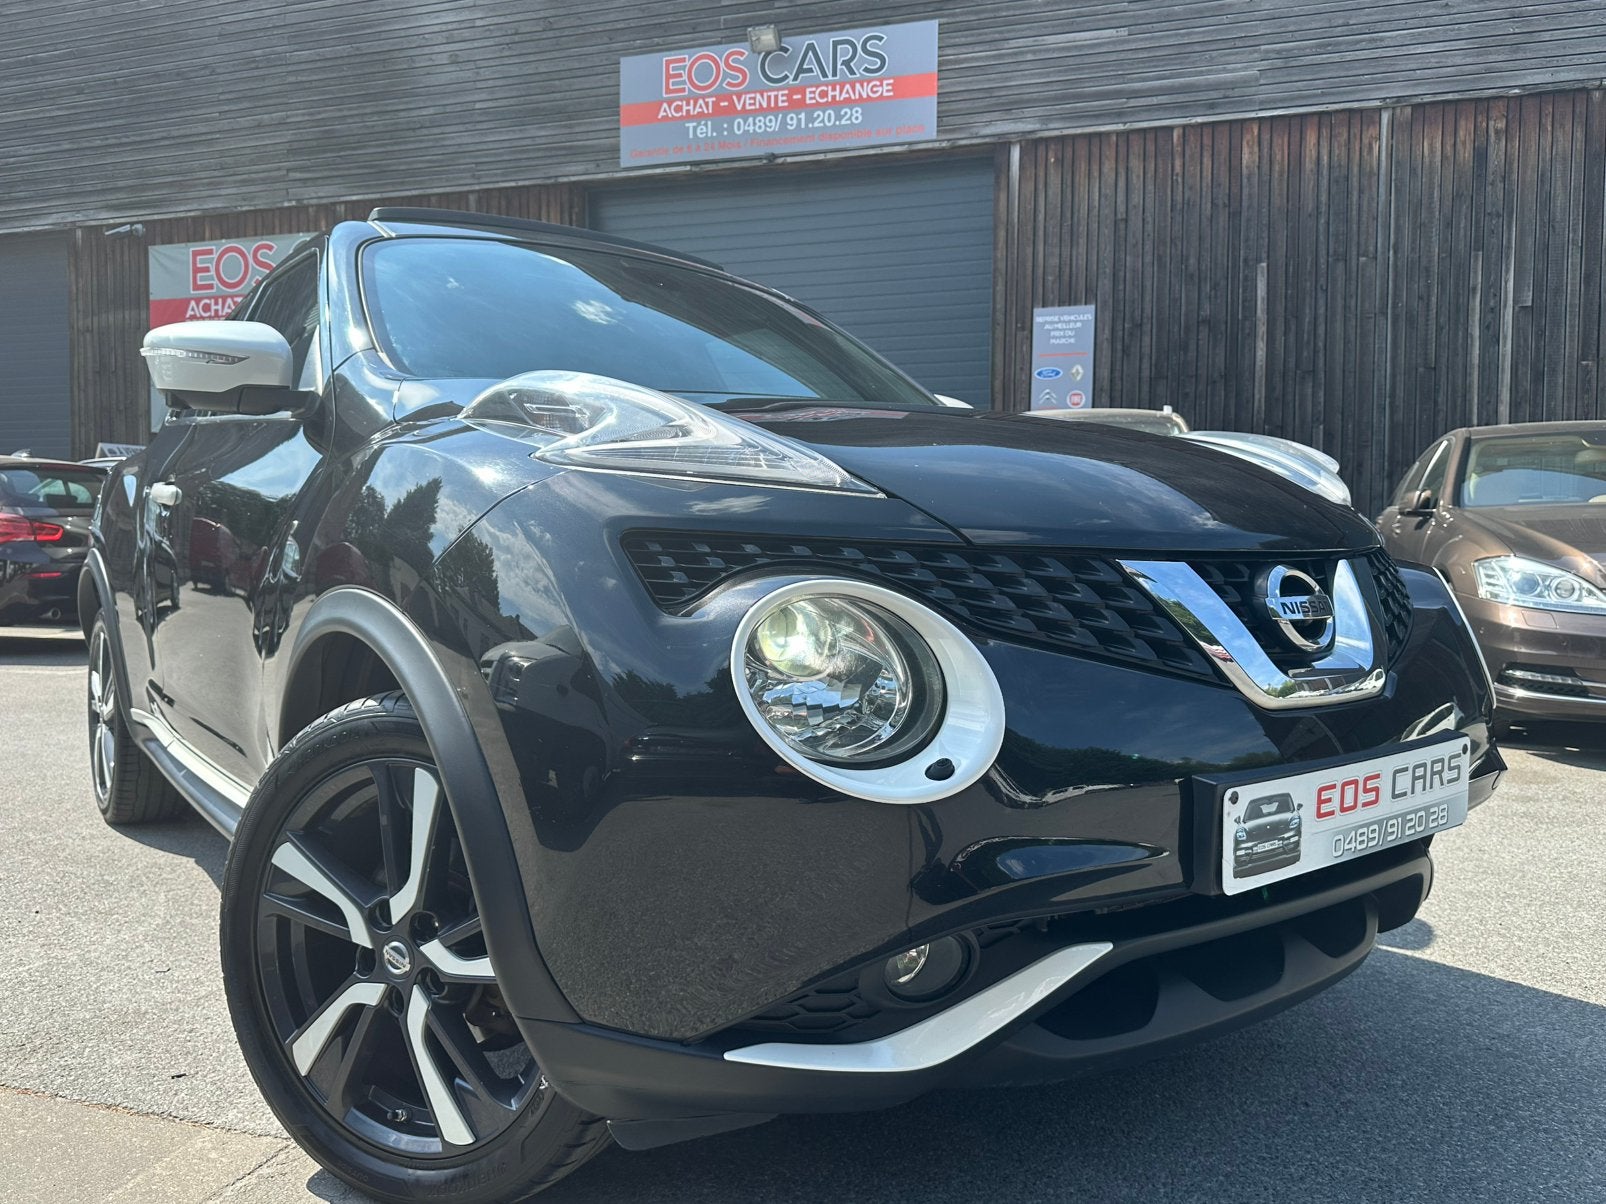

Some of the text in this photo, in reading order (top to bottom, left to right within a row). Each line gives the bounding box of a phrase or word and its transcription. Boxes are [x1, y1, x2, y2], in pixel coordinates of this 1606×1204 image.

[662, 32, 888, 98] EOS CARS
[657, 97, 716, 119] ACHAT
[732, 90, 789, 112] VENTE
[805, 79, 895, 104] ECHANGE
[685, 121, 717, 139] Tél.
[786, 107, 863, 131] 91.20.28
[190, 240, 278, 294] EOS
[1315, 752, 1463, 820] EOS CARS
[1332, 803, 1448, 857] 0489/91 20 28
